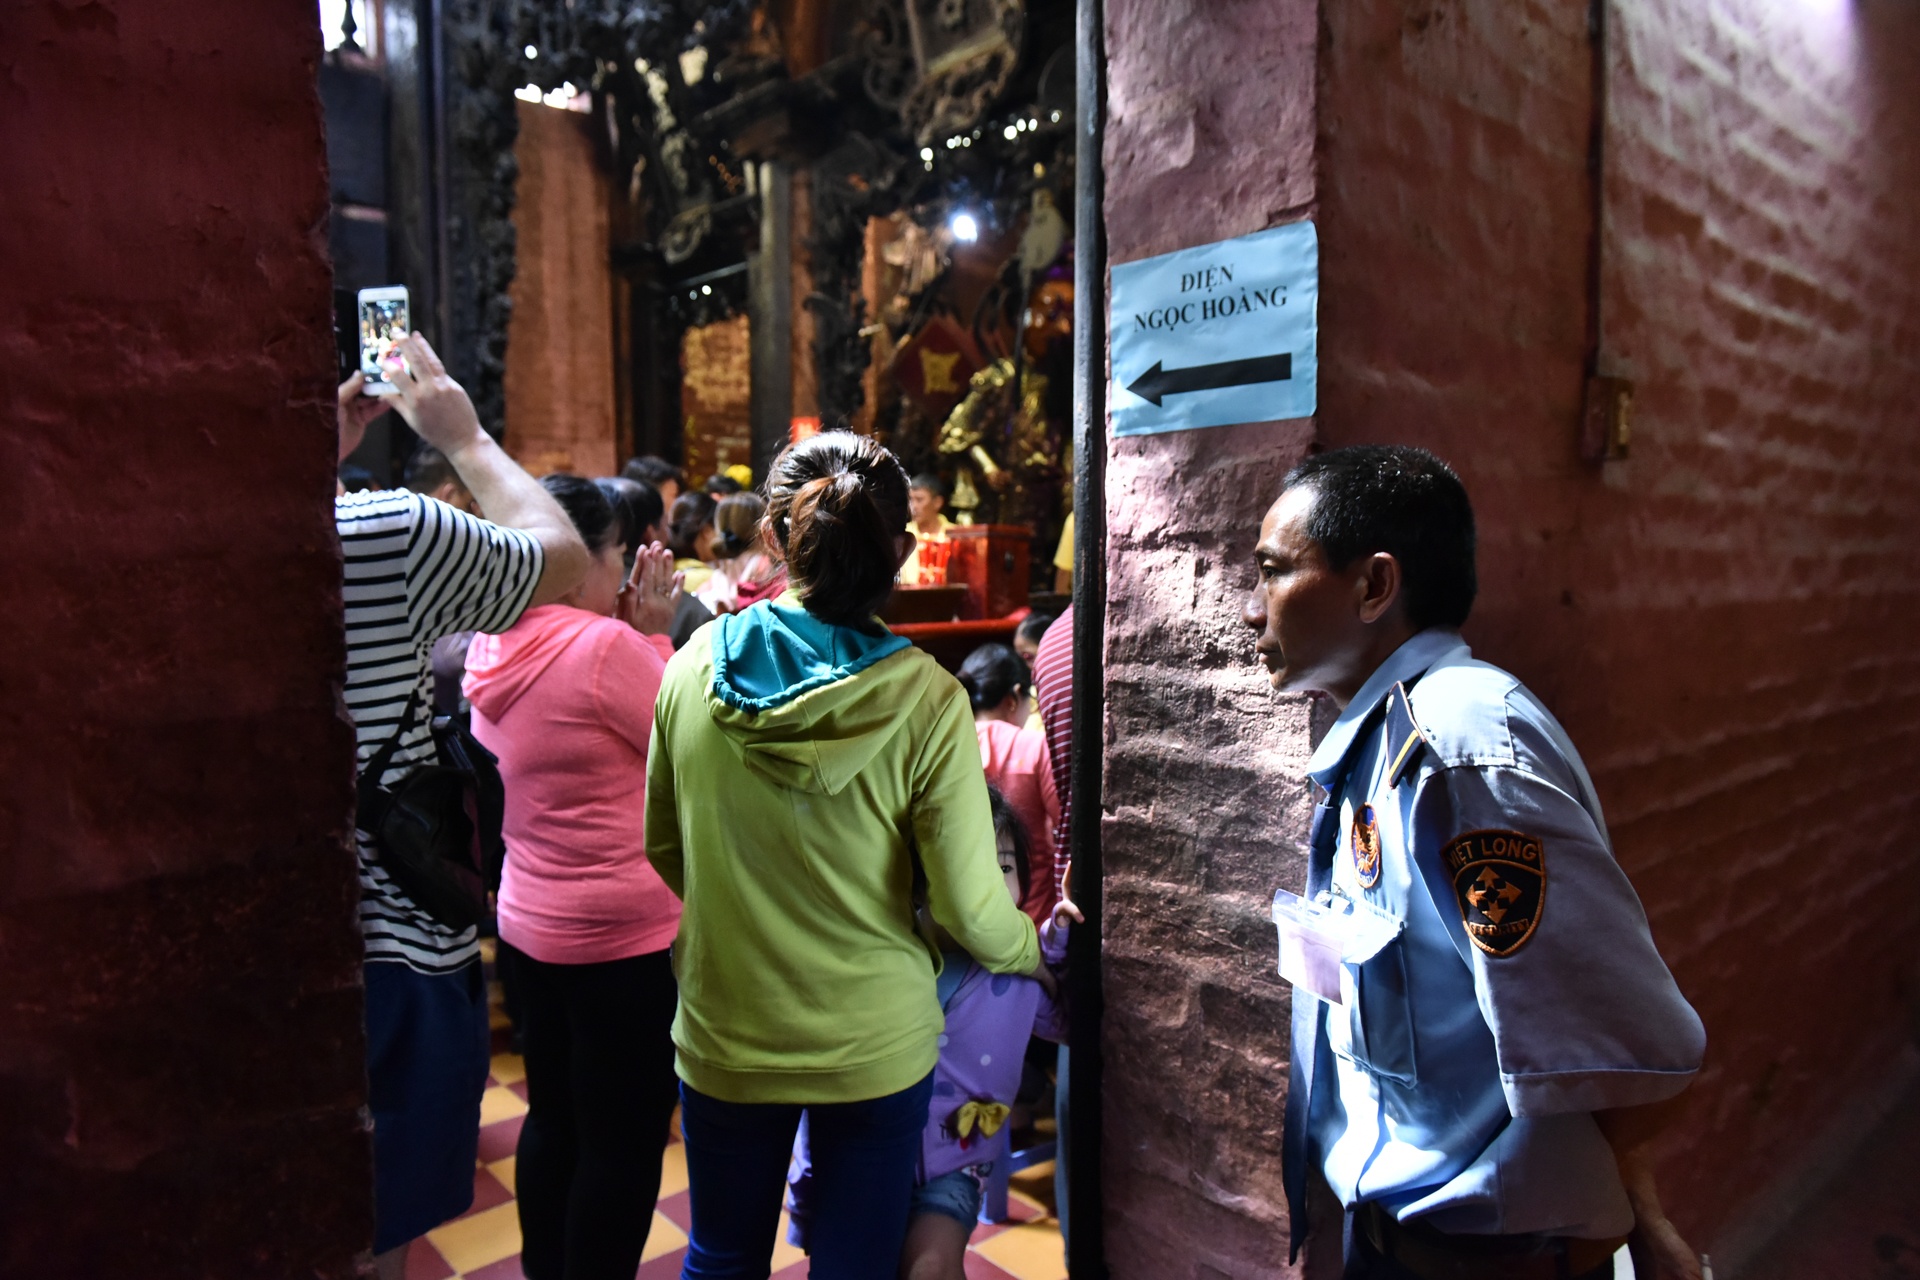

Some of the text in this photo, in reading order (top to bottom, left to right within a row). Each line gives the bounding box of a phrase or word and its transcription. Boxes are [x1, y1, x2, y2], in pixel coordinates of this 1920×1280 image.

[1181, 263, 1234, 293] ĐIỆN
[1134, 286, 1288, 332] NGỌC HOÀNG
[1481, 837, 1538, 861] LONG
